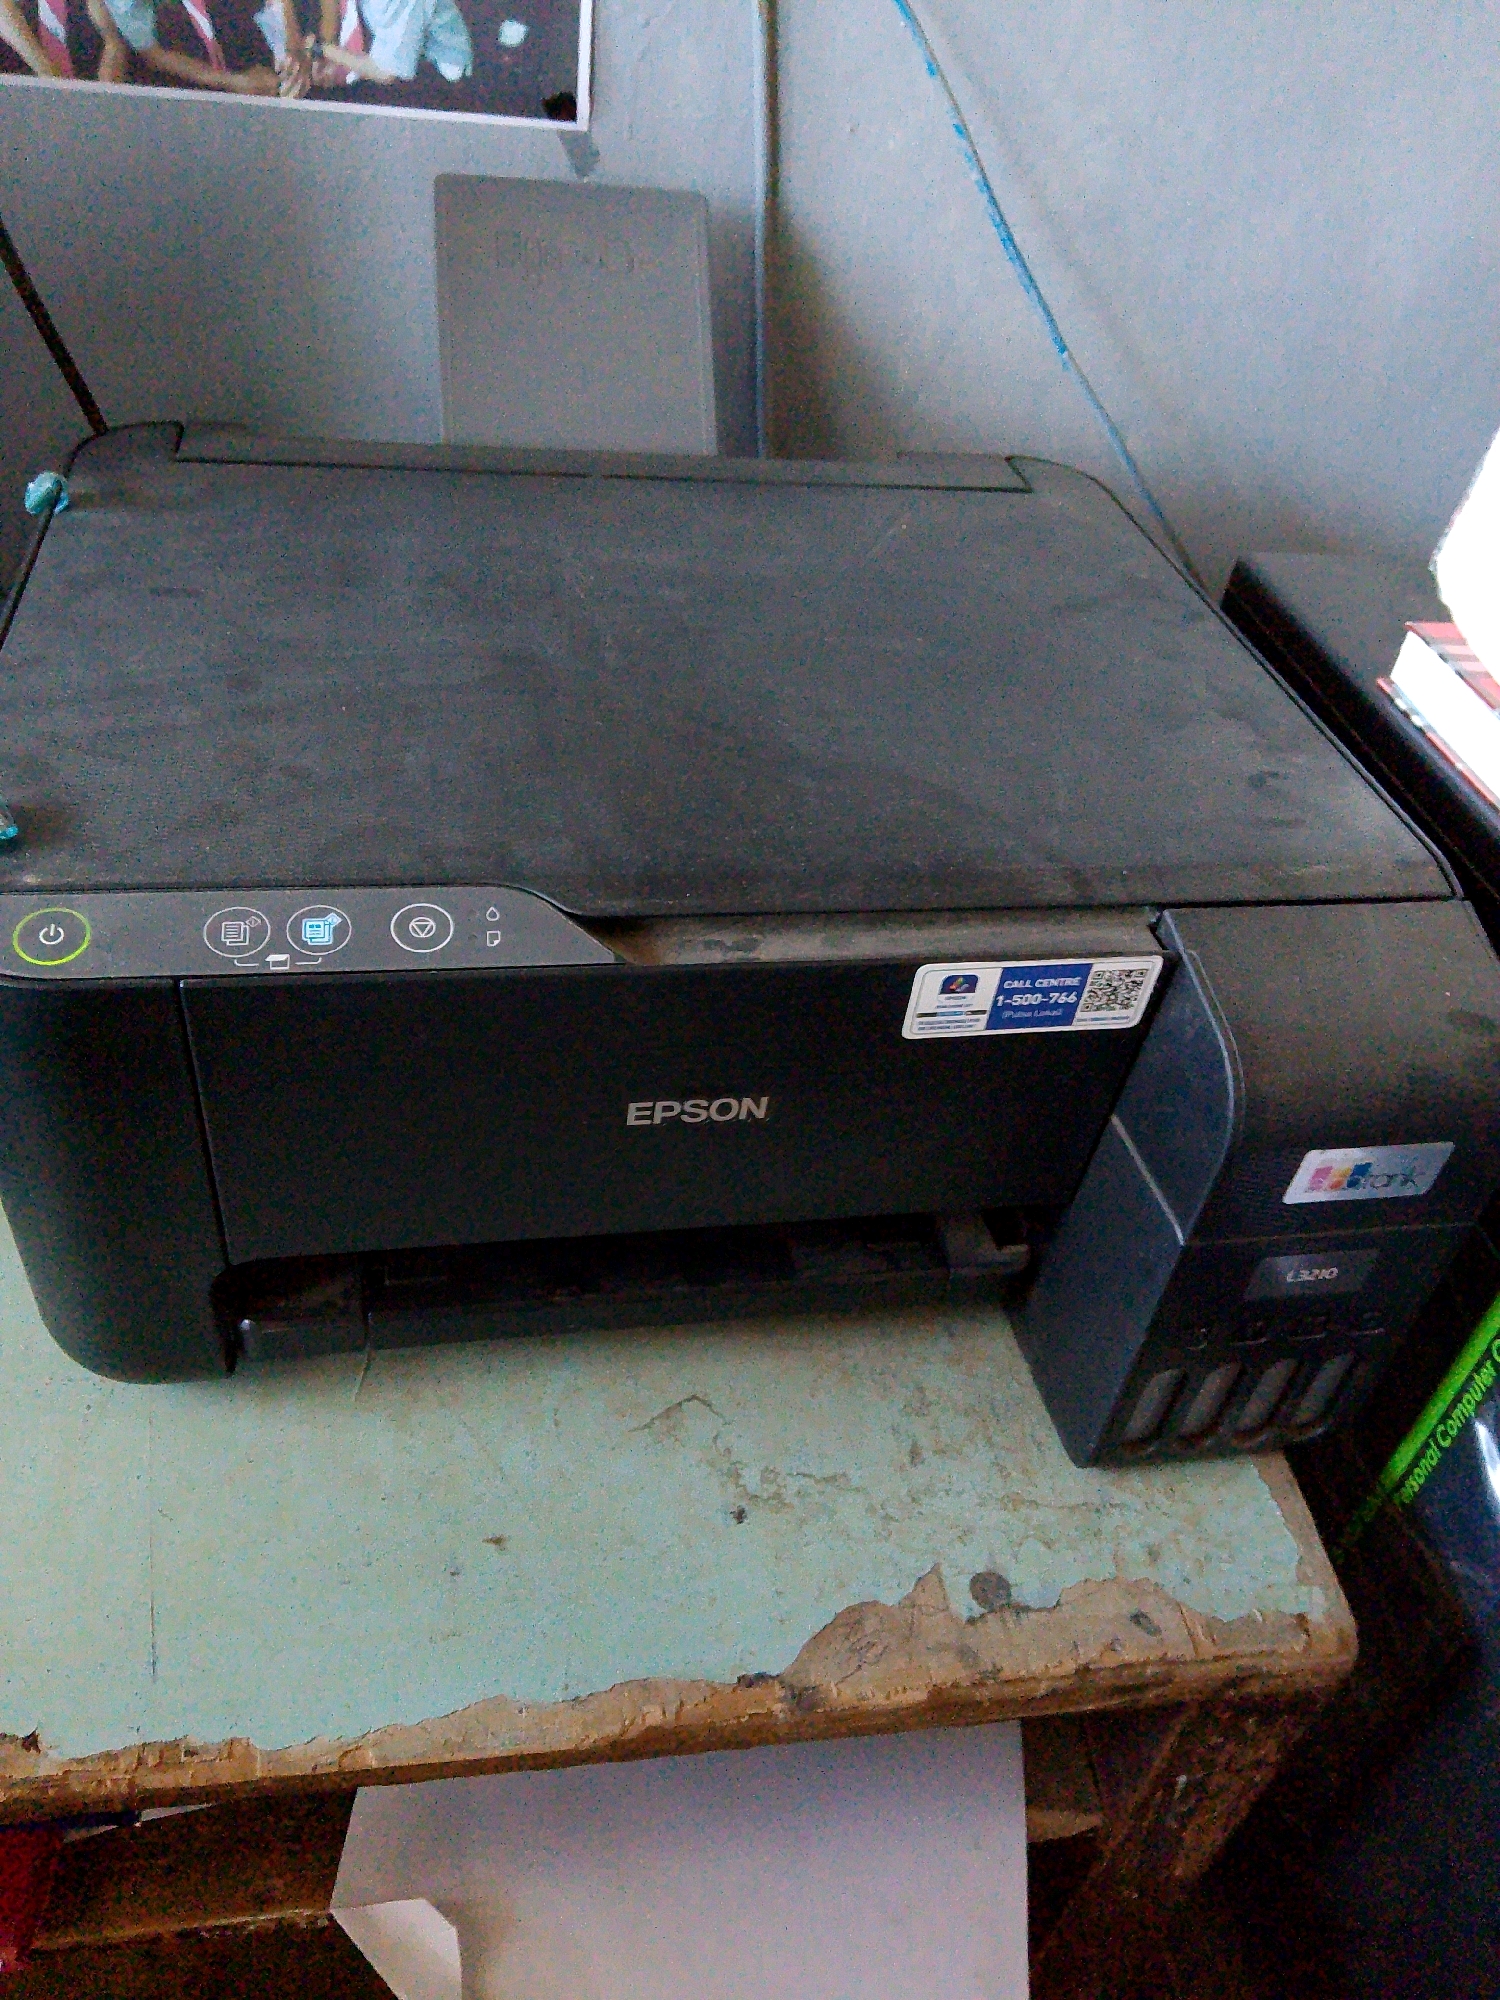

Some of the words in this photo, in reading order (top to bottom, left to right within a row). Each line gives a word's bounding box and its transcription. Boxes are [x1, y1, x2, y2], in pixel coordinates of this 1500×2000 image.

[1004, 979, 1032, 988] CALL
[1035, 977, 1081, 988] CENTRE
[996, 991, 1077, 1007] 1-500-766
[626, 1097, 769, 1126] EPSON
[1393, 1438, 1442, 1503] ersonal
[1436, 1359, 1497, 1448] Computer
